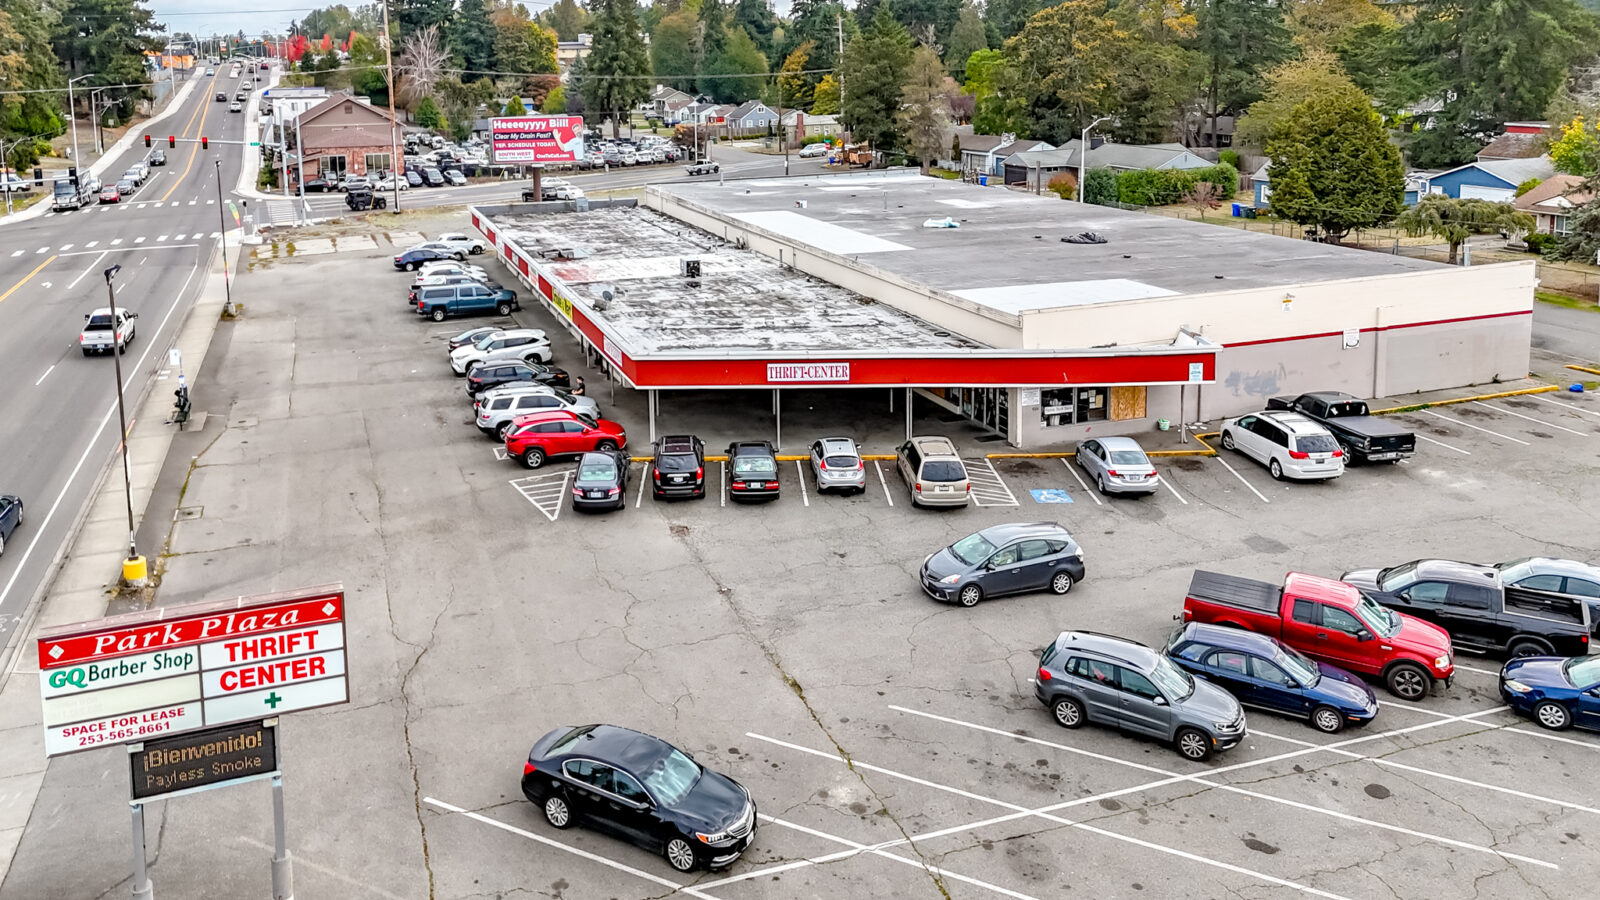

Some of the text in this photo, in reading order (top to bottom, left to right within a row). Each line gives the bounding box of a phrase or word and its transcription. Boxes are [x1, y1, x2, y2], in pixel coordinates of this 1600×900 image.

[768, 365, 848, 379] THRIFT-CENTER
[92, 609, 299, 655] Park Plaza
[224, 630, 319, 662] THRIFT
[48, 652, 193, 688] GQ Barber Shop
[219, 656, 326, 691] CENTER
[62, 707, 186, 738] SPACE FOR LEASE
[78, 721, 171, 747] 253-565-8661
[143, 731, 263, 772] ¡Bienvenido!
[146, 756, 262, 789] Payless Smoke
